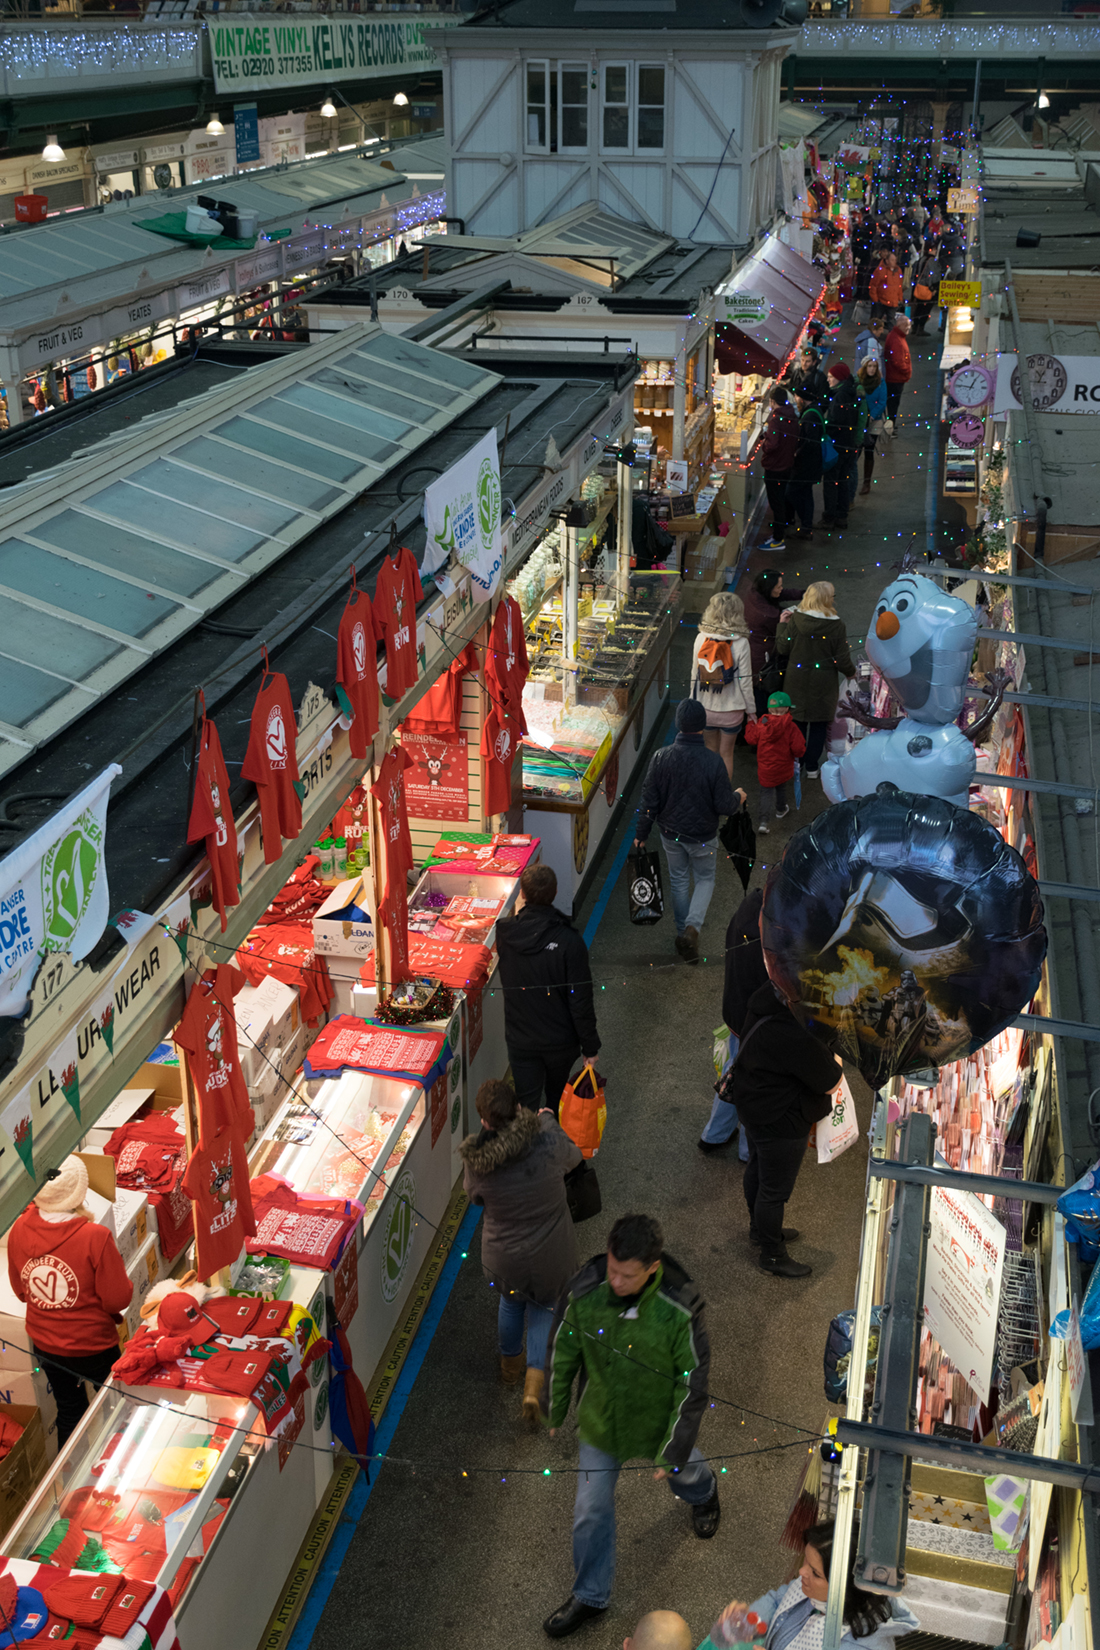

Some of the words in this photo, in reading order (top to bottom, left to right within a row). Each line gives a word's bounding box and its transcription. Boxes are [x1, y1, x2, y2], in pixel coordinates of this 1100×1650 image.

[211, 27, 271, 57] VINTAGE
[273, 26, 311, 54] VINYL
[357, 23, 404, 67] RECORDS
[214, 59, 239, 79] TEL:
[242, 57, 275, 77] 02920
[278, 55, 313, 75] 377355
[392, 290, 408, 299] 170
[577, 296, 593, 305] 167
[940, 282, 971, 291] Bailey's
[940, 290, 969, 299] Sewing
[127, 303, 152, 323] YEATES
[38, 334, 59, 354] FRUIT
[61, 332, 67, 345] &
[67, 326, 83, 343] VEG
[951, 433, 983, 447] BATTERIES
[306, 692, 320, 719] 175
[407, 783, 430, 791] SATURDAY
[41, 961, 64, 1001] 177
[114, 945, 161, 1015] WEAR
[450, 1194, 467, 1221] CAUTION
[22, 1256, 55, 1281] REINDEER
[57, 1261, 75, 1283] RUN
[420, 1261, 440, 1291] CAUTION
[403, 1295, 426, 1335] ATTENTION
[387, 1337, 408, 1371] CAUTION
[369, 1375, 393, 1419] ATTENTION
[324, 1465, 354, 1515] ATTENTION
[303, 1518, 331, 1561] CAUTION
[277, 1567, 309, 1625] ATTENTION
